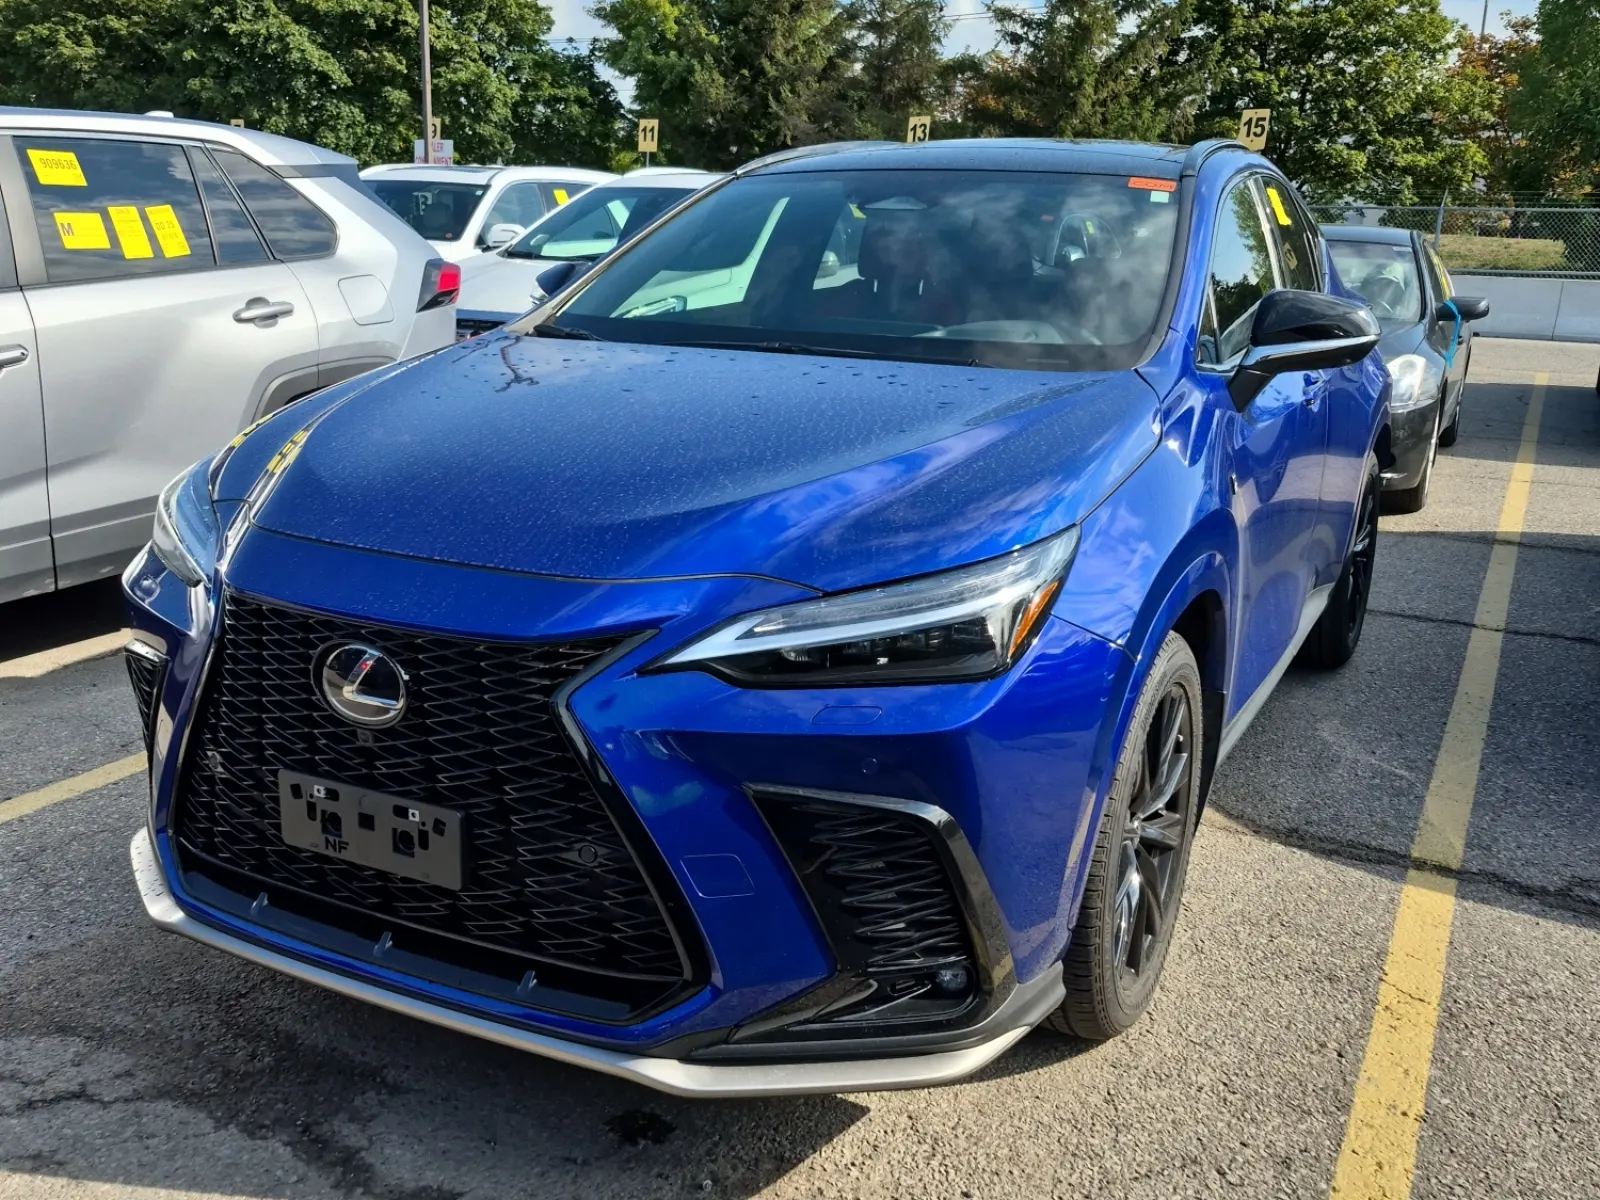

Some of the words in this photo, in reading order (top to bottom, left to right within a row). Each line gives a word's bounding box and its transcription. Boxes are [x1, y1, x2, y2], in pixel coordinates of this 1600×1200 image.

[641, 125, 655, 142] 11
[910, 123, 928, 142] 13
[1243, 117, 1267, 138] 15
[59, 222, 75, 237] M
[325, 835, 350, 854] NF
